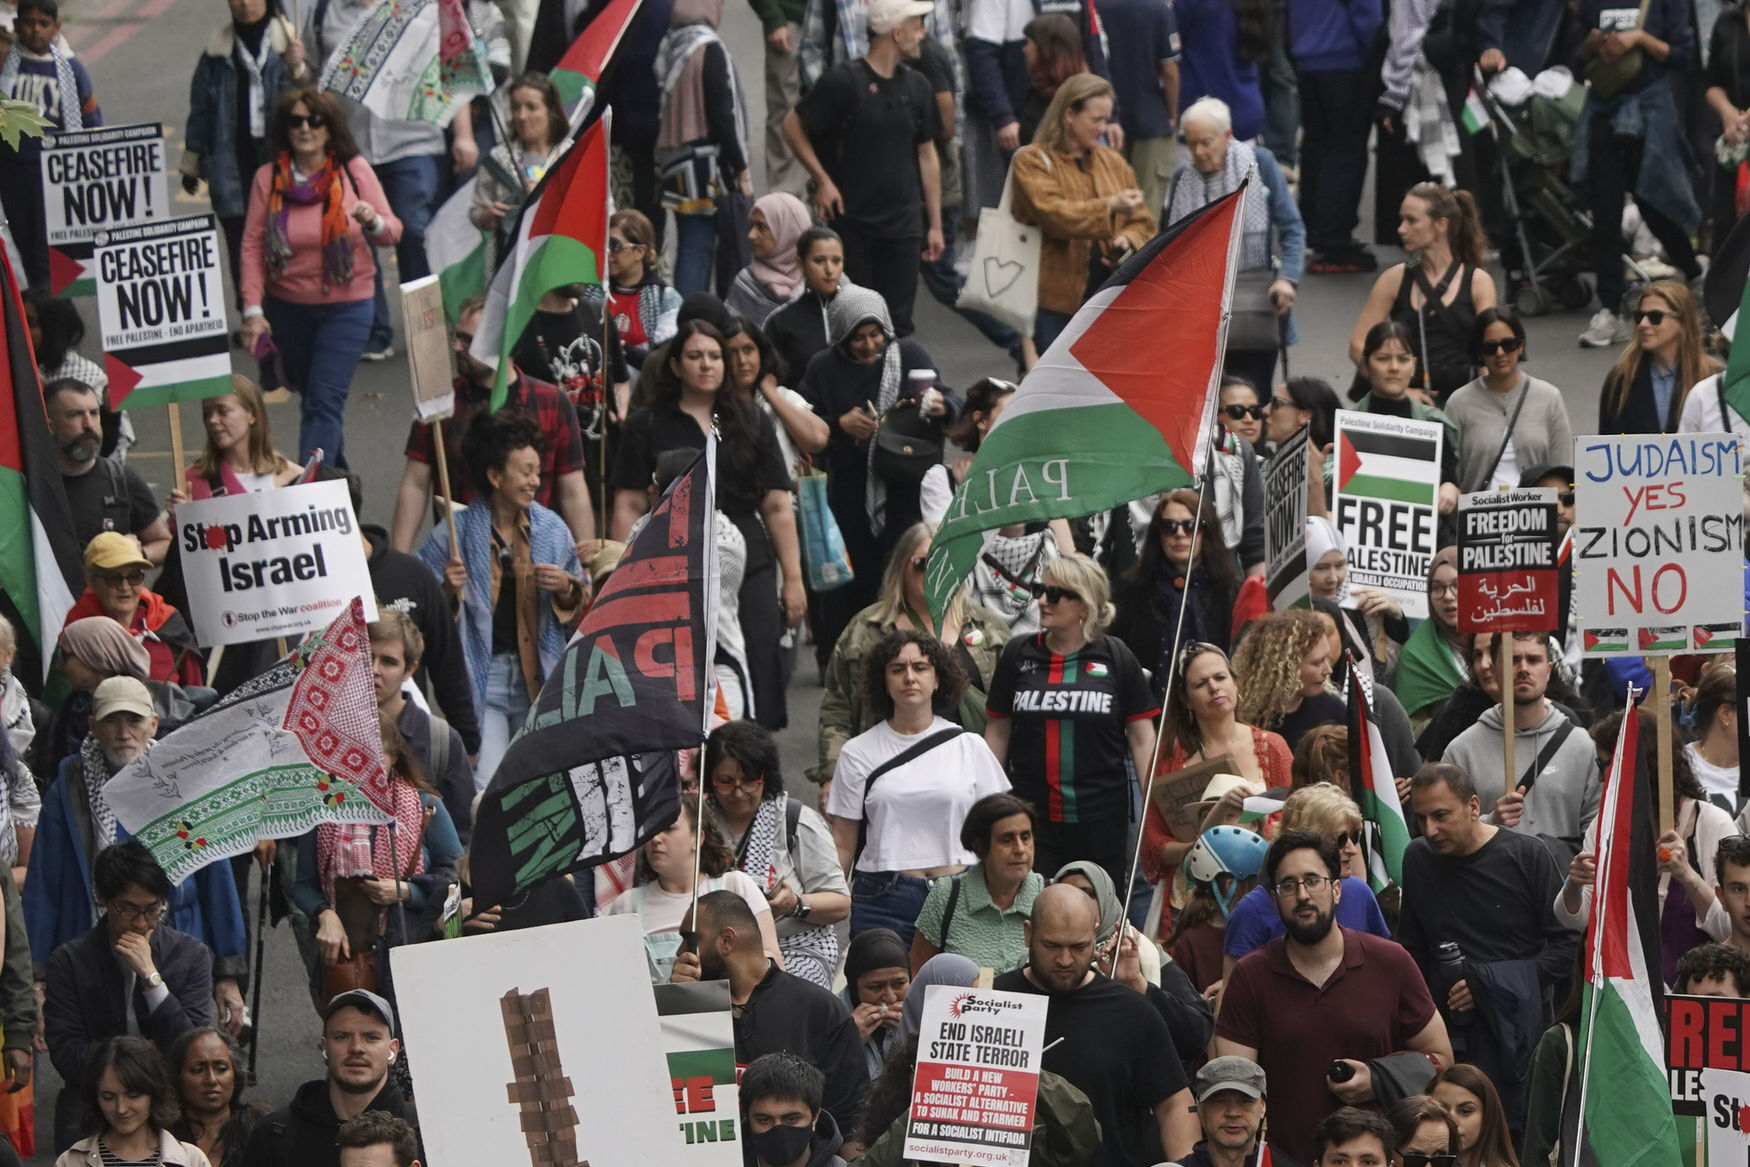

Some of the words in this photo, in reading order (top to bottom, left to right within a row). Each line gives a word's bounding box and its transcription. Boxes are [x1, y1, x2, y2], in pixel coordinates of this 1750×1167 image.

[47, 143, 161, 184] CEASEFIRE
[100, 236, 215, 284] CEASEFIRE
[1585, 439, 1740, 483] JUDAISM
[1622, 481, 1686, 527] YES
[1337, 497, 1432, 554] FREE
[1466, 508, 1547, 535] FREEDOM
[1501, 533, 1514, 544] for
[1578, 512, 1742, 559] ZIONISM
[219, 542, 327, 592] Israel
[1463, 542, 1552, 570] PALESTINE
[1478, 575, 1536, 599] الحرية
[1607, 562, 1687, 616] NO
[1471, 598, 1545, 623] لفلسطين
[1013, 690, 1113, 714] PALESTINE
[966, 995, 1023, 1010] Socialist
[939, 1021, 967, 1042] END
[970, 1024, 1025, 1048] ISRAELI
[929, 1041, 971, 1063] STATE
[975, 1046, 1030, 1068] TERROR
[909, 1143, 1008, 1162] socialistparty.org.uk
